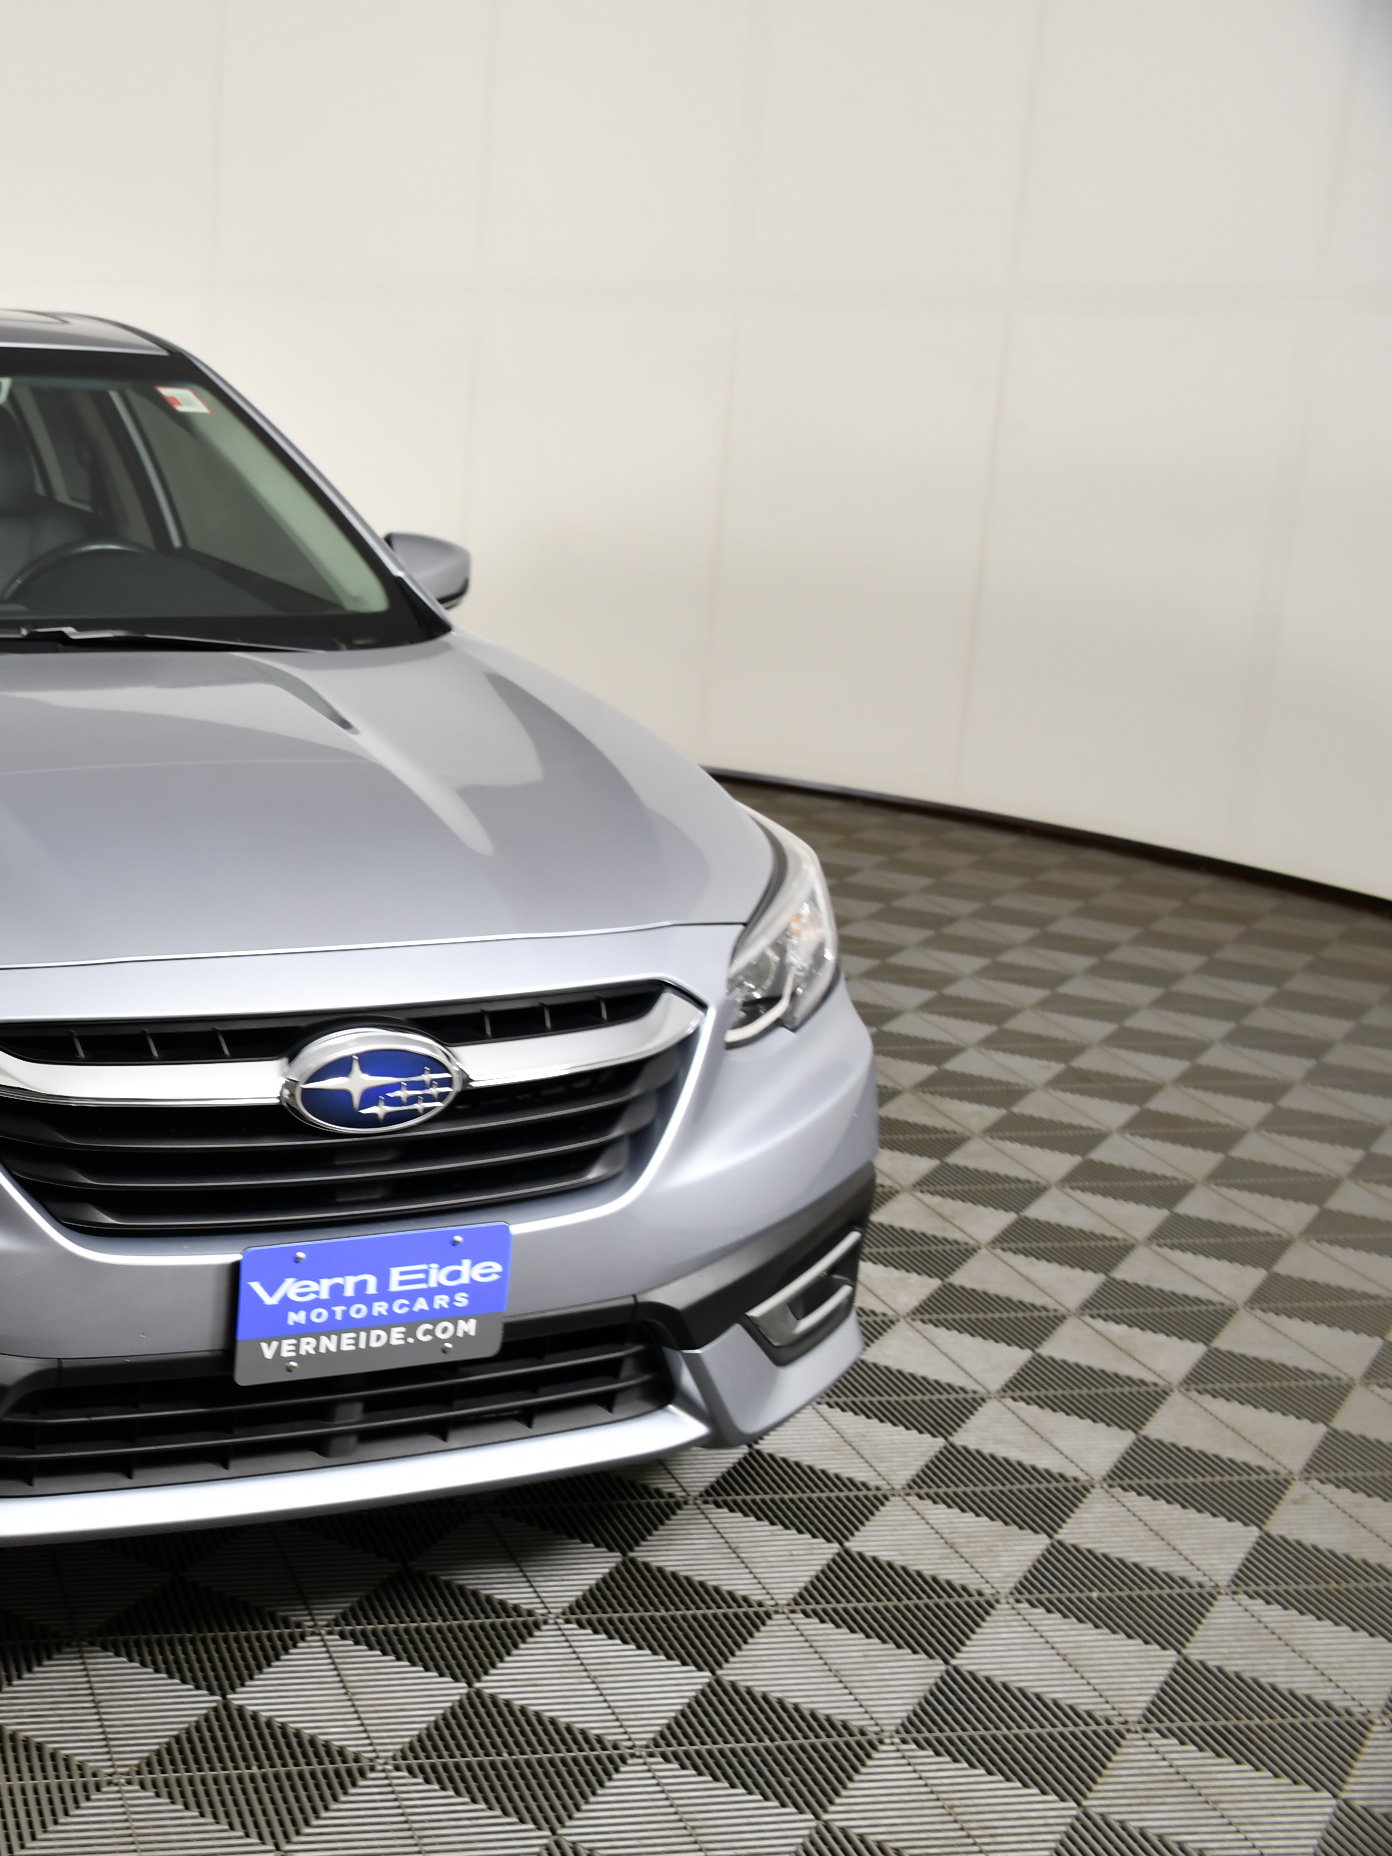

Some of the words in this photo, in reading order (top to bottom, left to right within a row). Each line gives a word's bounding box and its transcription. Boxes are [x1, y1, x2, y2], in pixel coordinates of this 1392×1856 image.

[247, 1273, 378, 1305] Vern
[386, 1258, 503, 1293] Eide
[286, 1292, 470, 1326] MOTORCARS
[259, 1318, 477, 1360] VERNEIDE.COM
